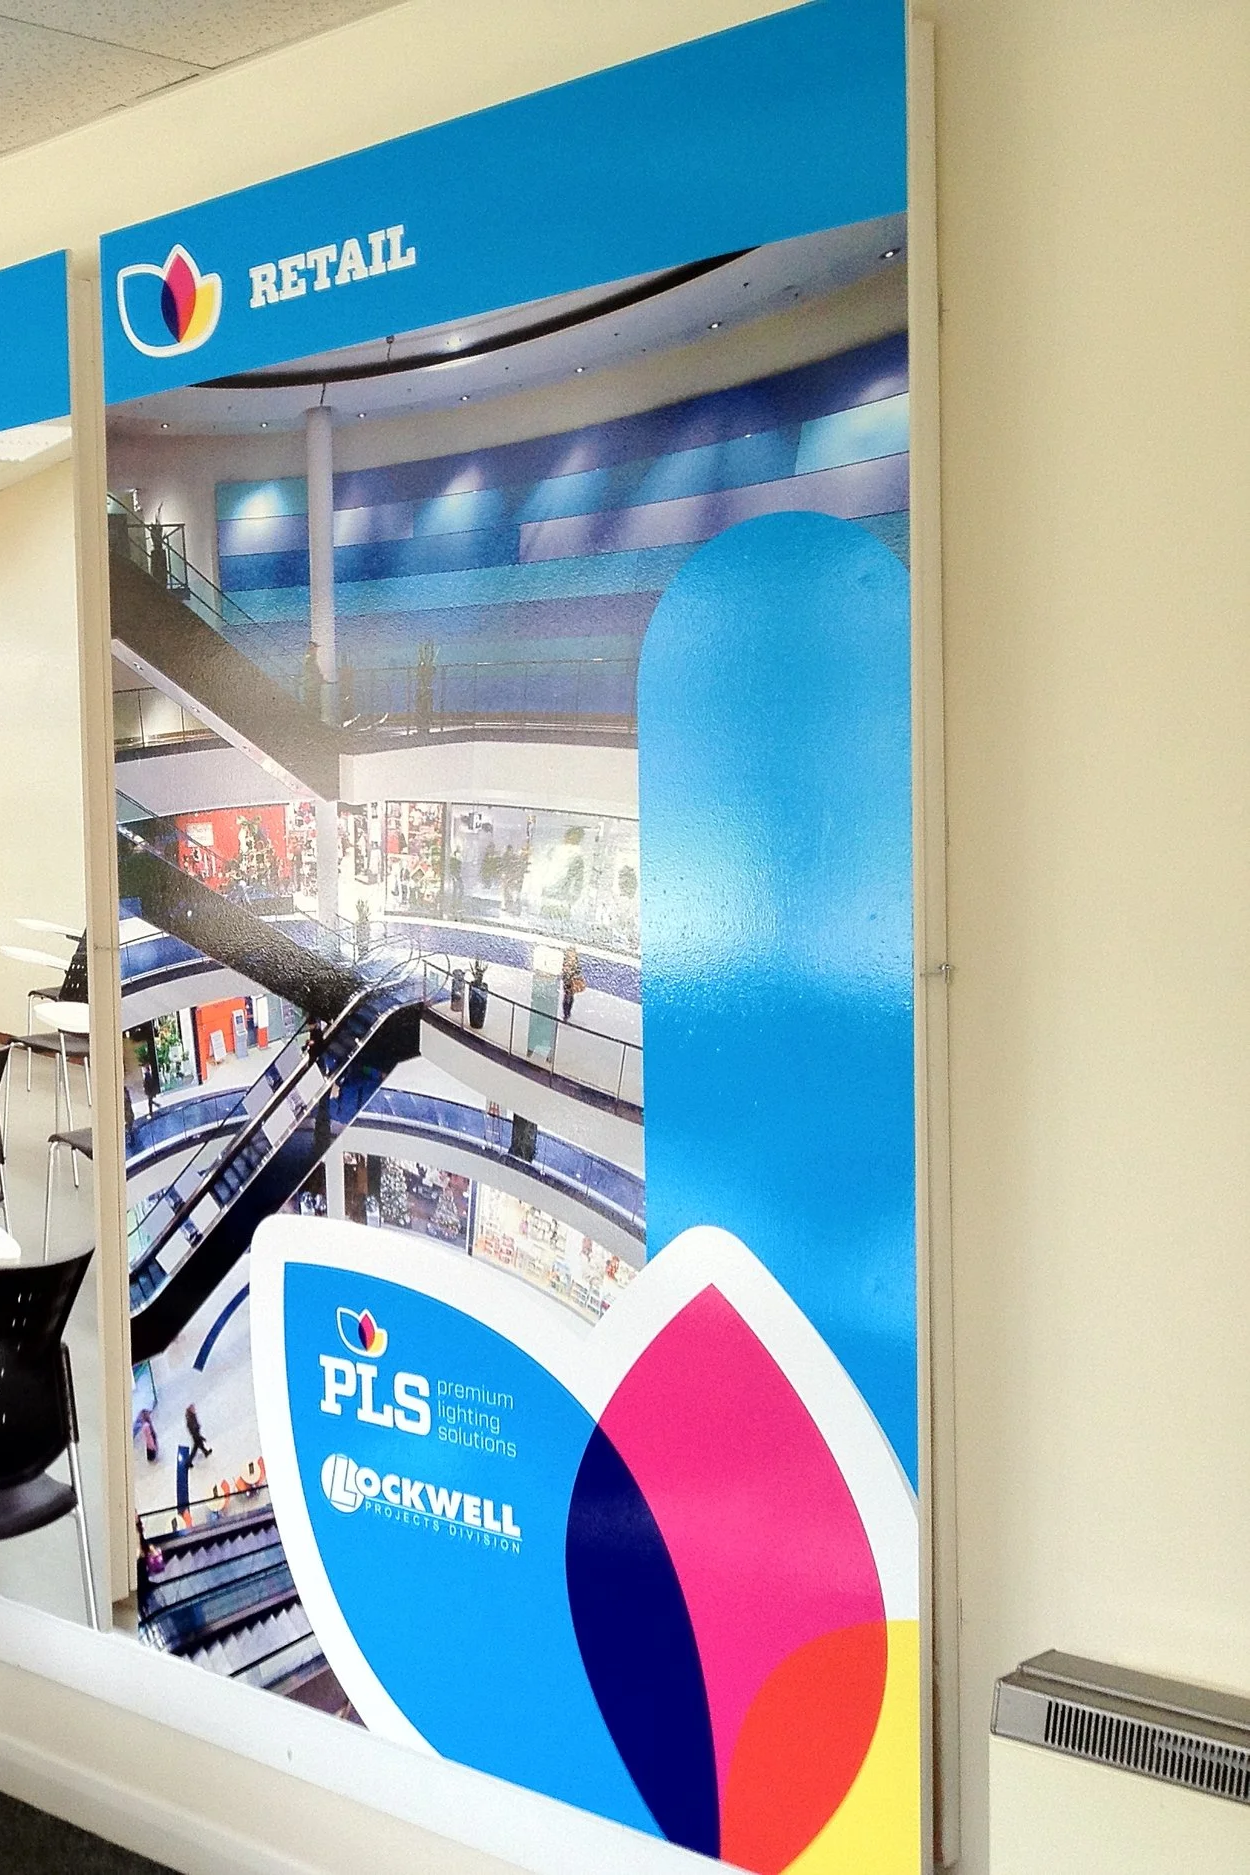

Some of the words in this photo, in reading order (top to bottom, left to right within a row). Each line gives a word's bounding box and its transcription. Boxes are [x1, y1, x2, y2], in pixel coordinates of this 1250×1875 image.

[249, 225, 417, 309] RETAIL
[319, 1354, 431, 1437] PLS
[437, 1378, 514, 1410] premium
[437, 1401, 501, 1434] lighting
[437, 1427, 517, 1458] solutions
[321, 1453, 521, 1538] LOCKWELL
[365, 1501, 440, 1532] PROJECTS
[449, 1525, 521, 1555] DIVISION
